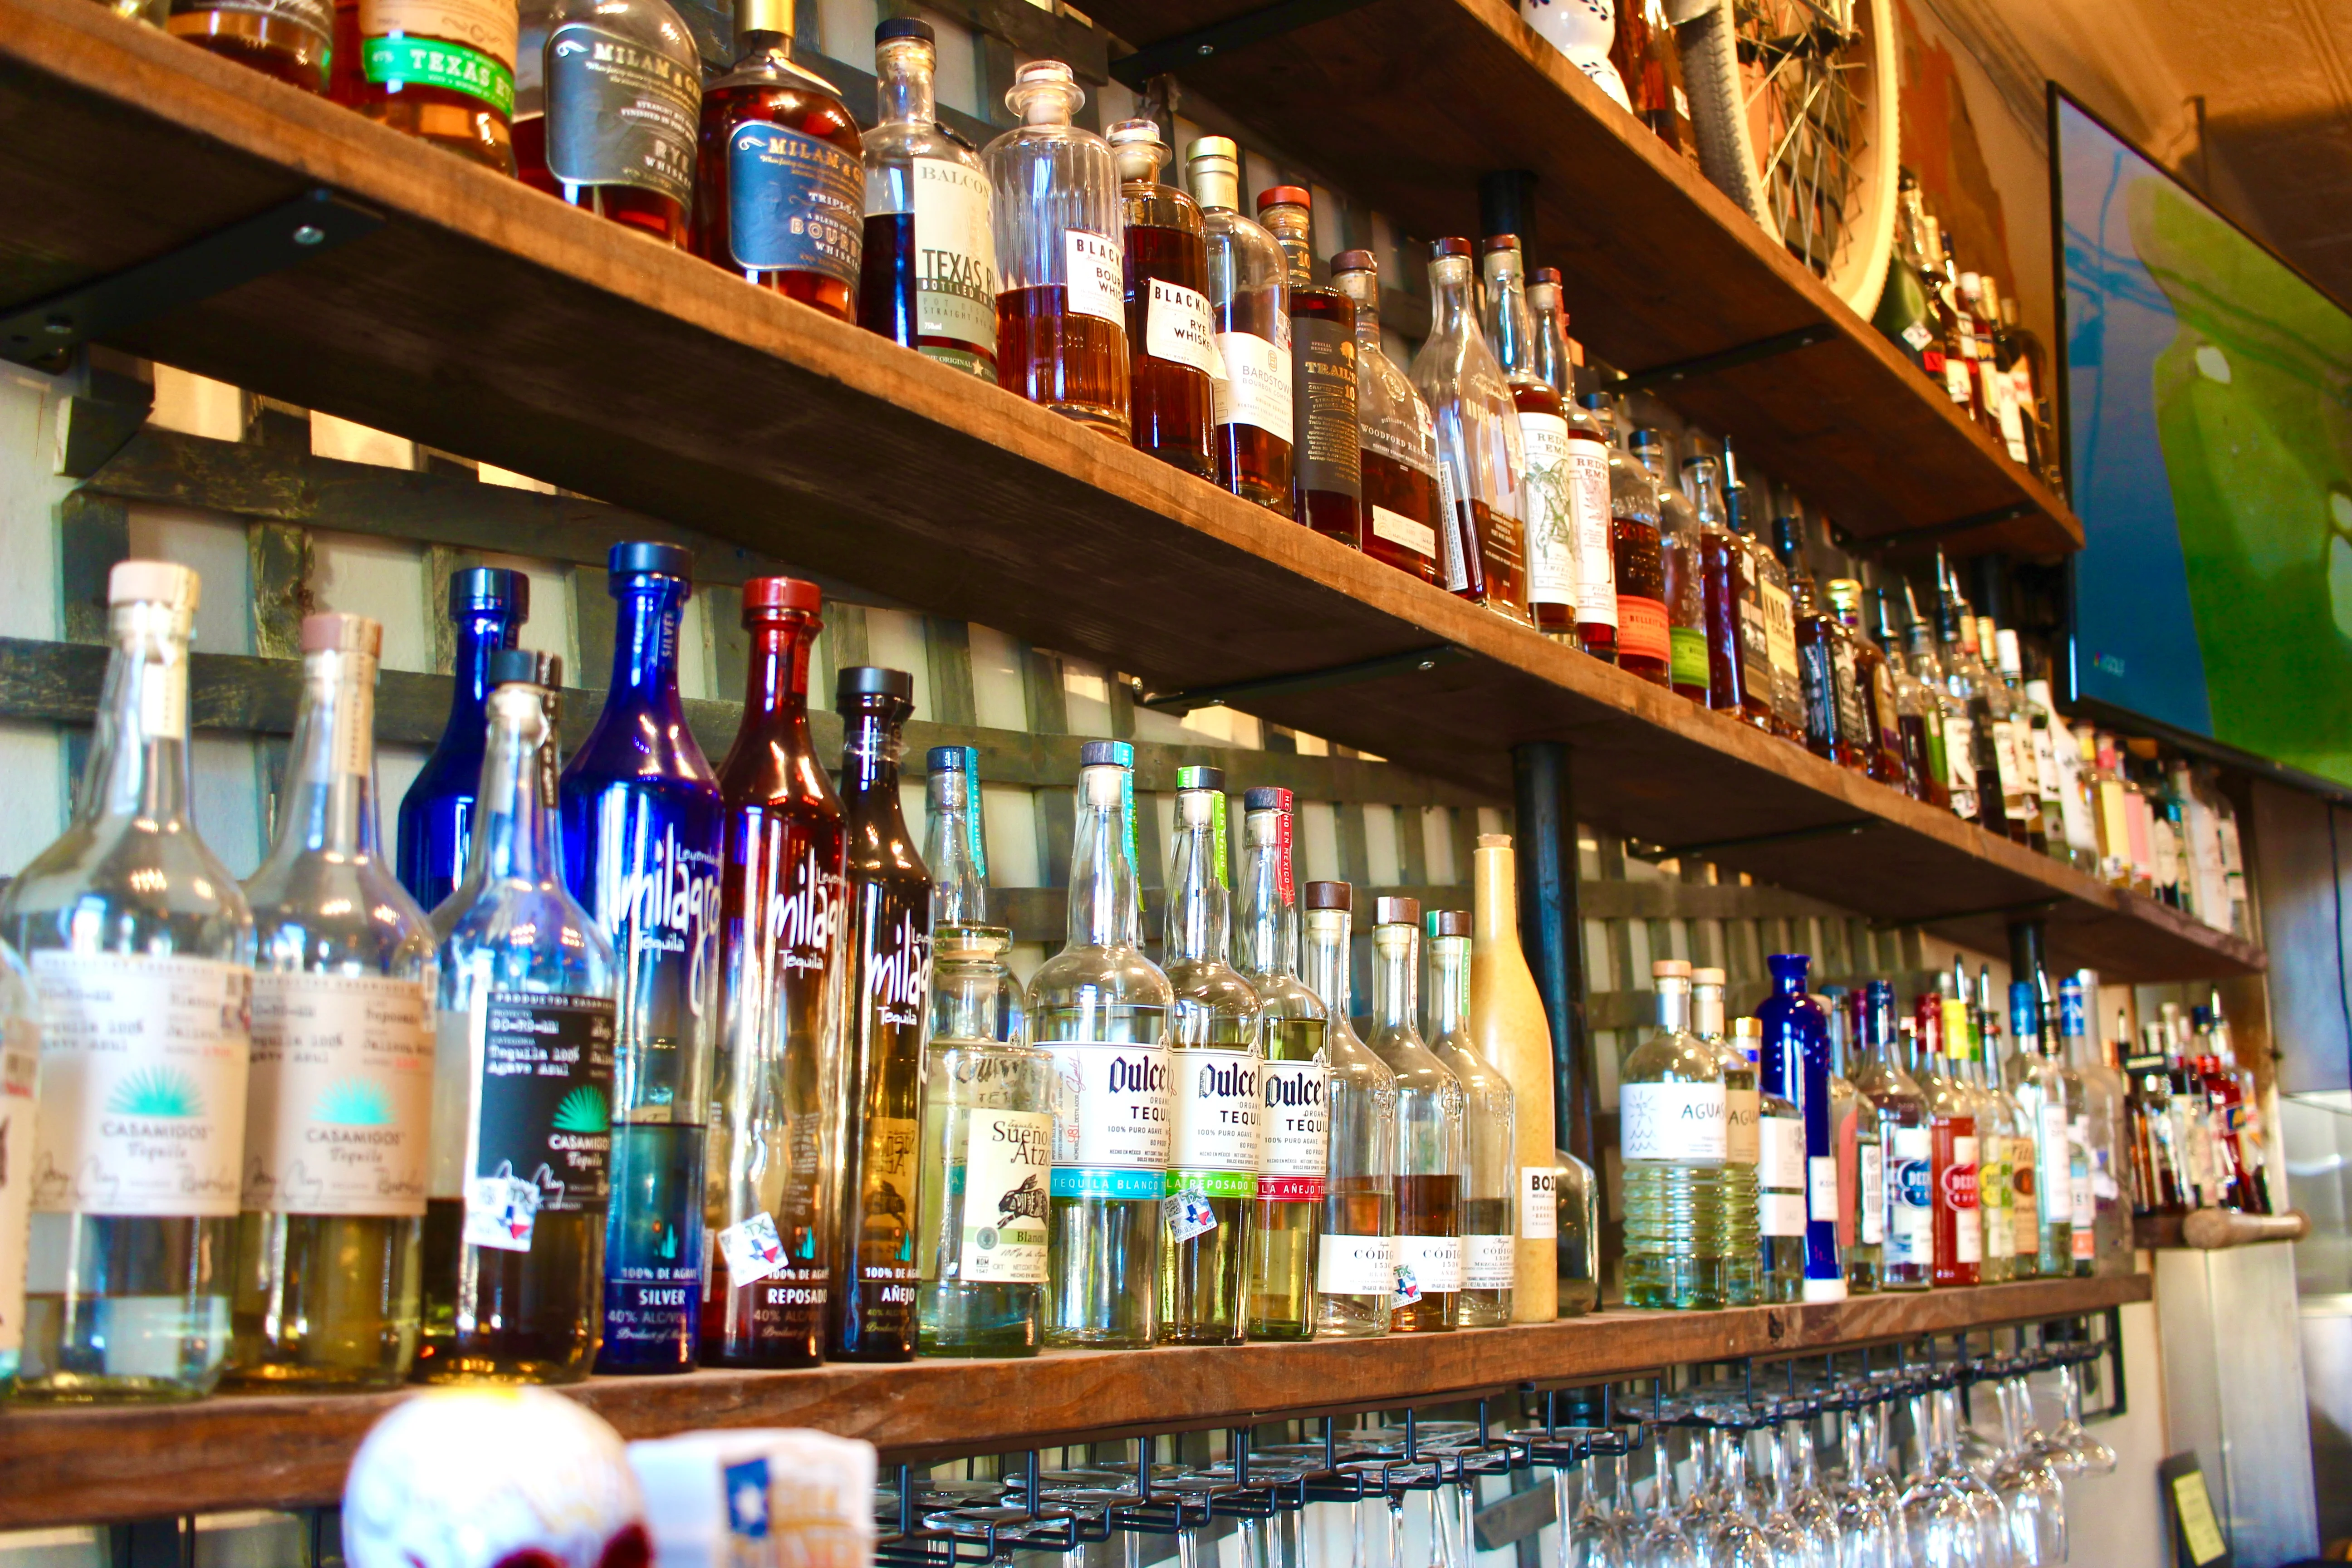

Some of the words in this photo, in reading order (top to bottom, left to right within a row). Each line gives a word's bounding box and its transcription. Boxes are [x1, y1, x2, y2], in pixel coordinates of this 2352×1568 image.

[409, 49, 491, 87] TEXAS
[594, 42, 670, 79] MILAM
[769, 137, 839, 169] MILAM
[808, 191, 852, 215] TRIPLE
[807, 212, 813, 220] A
[814, 214, 839, 228] BLEND
[922, 249, 982, 289] TEXAS
[1297, 250, 1311, 270] 10
[922, 279, 974, 298] BOTTLED
[923, 298, 949, 308] POT
[924, 306, 971, 321] STRAIGHT
[1190, 319, 1207, 337] RYE
[1174, 327, 1213, 355] WHISKEY
[939, 356, 972, 369] ORIGINAL
[1305, 362, 1357, 386] TRAIL'S
[1242, 377, 1272, 394] BOURBON
[1361, 423, 1406, 448] WOODFORD
[1407, 441, 1436, 465] RESERVE
[1220, 813, 1225, 826] EN
[1284, 833, 1289, 843] EN
[637, 931, 685, 961] Tequila
[777, 950, 824, 979] Tequila
[494, 992, 568, 1006] PRODUCTOS
[877, 1006, 917, 1035] Tequila
[488, 1044, 549, 1062] Tequila
[552, 1045, 580, 1064] 100%
[487, 1060, 532, 1076] Agave
[537, 1063, 570, 1077] Azul
[1109, 1054, 1166, 1094] Dulce
[1198, 1061, 1256, 1099] Dulce
[1265, 1072, 1322, 1108] Dulce
[1053, 1178, 1109, 1189] TEQUILA
[1117, 1179, 1158, 1191] BLANCO
[1189, 1179, 1248, 1191] REPOSADO
[1283, 1183, 1315, 1194] AÑEJO
[1181, 1188, 1203, 1204] TX
[1017, 1231, 1044, 1243] Blanco
[621, 1266, 654, 1279] 100%
[657, 1267, 670, 1279] DE
[768, 1268, 796, 1280] 100%
[798, 1269, 810, 1280] DE
[865, 1266, 893, 1279] 100%
[895, 1268, 906, 1279] DE
[638, 1288, 686, 1306] SILVER
[767, 1288, 828, 1304] REPOSADO
[881, 1284, 915, 1306] AÑEJO
